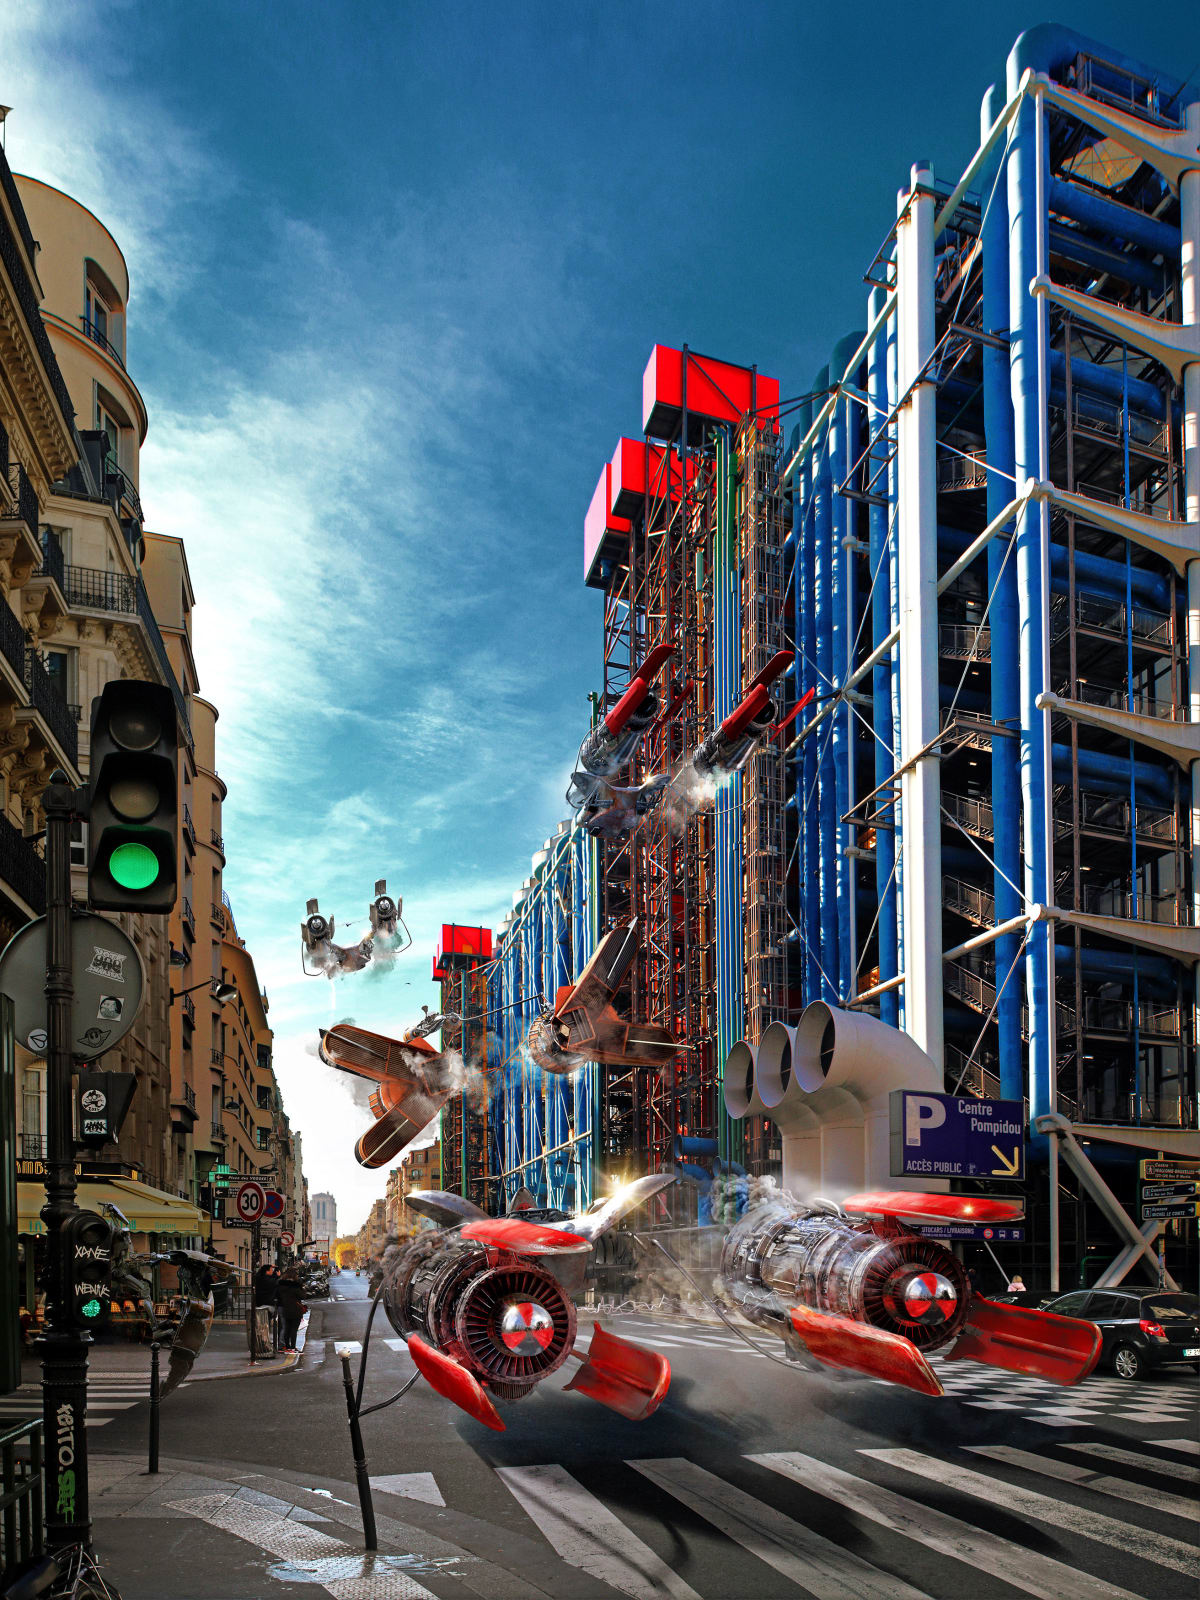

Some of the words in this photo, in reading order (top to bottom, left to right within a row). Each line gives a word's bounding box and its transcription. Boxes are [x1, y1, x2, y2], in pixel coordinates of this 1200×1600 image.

[958, 1099, 993, 1116] Centre
[906, 1095, 946, 1146] P
[970, 1117, 1021, 1137] Pompidou
[906, 1158, 932, 1172] ACCÈS
[933, 1161, 962, 1174] PUBLIC
[241, 1193, 259, 1211] 30
